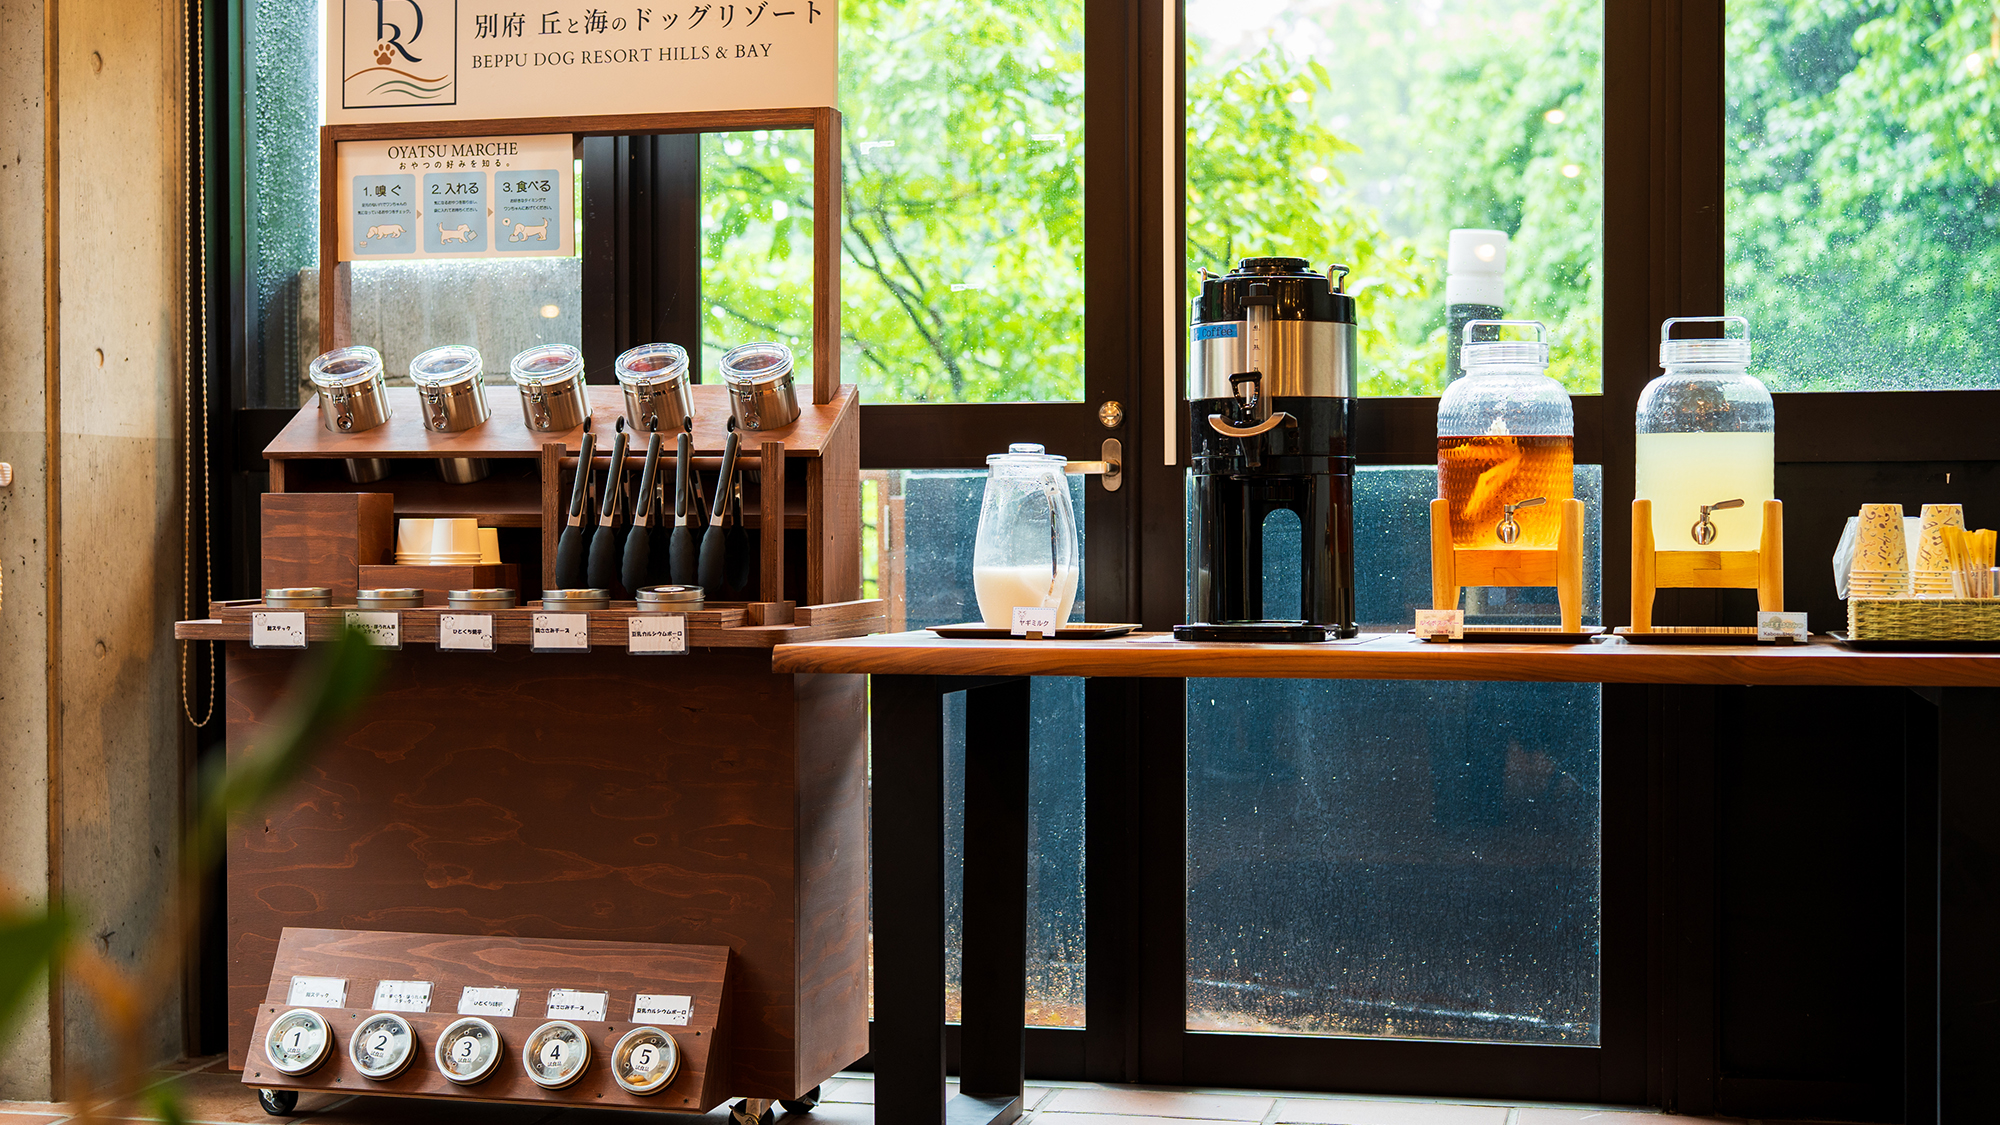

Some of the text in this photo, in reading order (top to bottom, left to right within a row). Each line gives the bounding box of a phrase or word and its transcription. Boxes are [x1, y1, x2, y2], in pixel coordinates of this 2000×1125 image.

[474, 1, 821, 40] 別府 丘と海のドッグリゾート
[472, 43, 773, 69] BEPPU DOG RESORT HILLS & BAY
[387, 142, 519, 160] OYATSU MARCHE
[398, 159, 511, 170] おやつの好みを知る。
[1202, 326, 1233, 338] Coffee
[1019, 619, 1049, 627] ヤギミルク
[293, 1031, 301, 1047] 1
[374, 1035, 388, 1051] 2
[461, 1041, 473, 1057] 3
[550, 1044, 561, 1060] 4
[639, 1049, 652, 1065] 5
